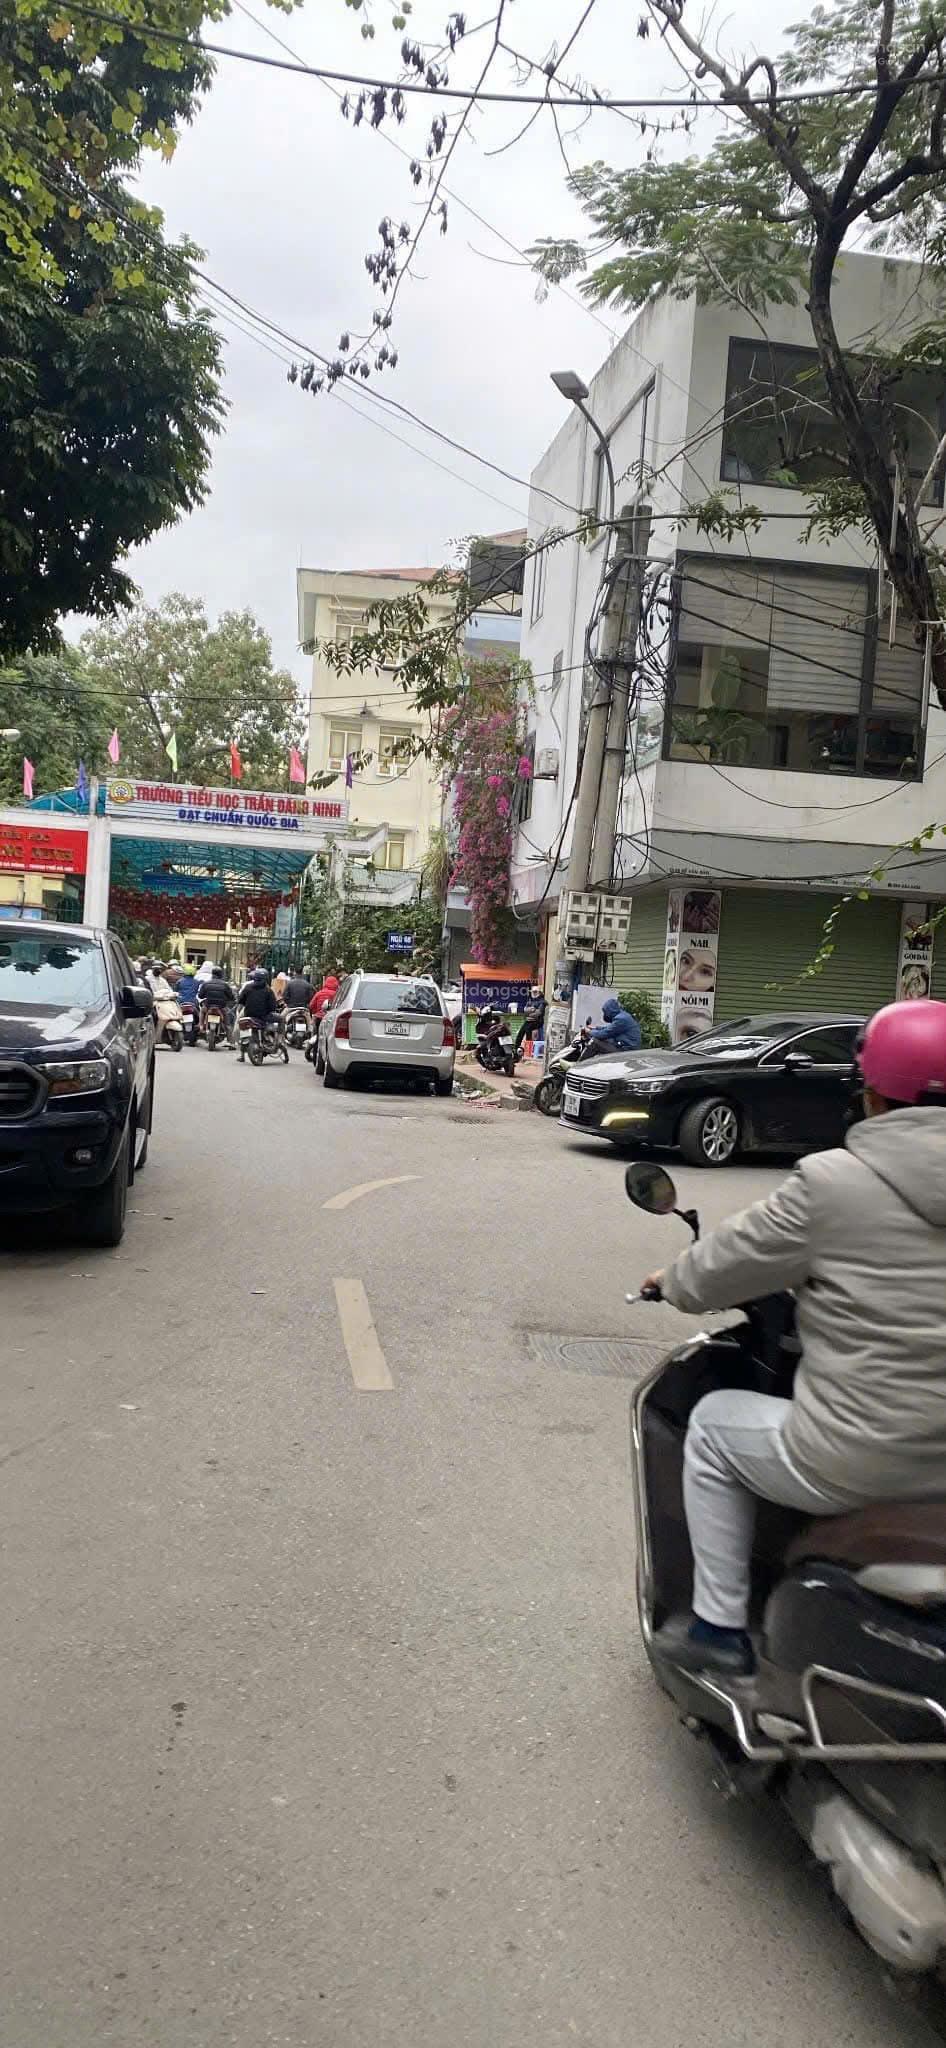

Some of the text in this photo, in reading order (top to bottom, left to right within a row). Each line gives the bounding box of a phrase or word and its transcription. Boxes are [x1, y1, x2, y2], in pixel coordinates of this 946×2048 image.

[136, 785, 183, 804] TRƯỜNG
[187, 788, 213, 807] TIỂU
[216, 793, 240, 811] HỌC
[243, 793, 275, 812] TRẦN
[313, 802, 341, 817] NINH
[178, 809, 299, 829] ĐẠT CHUẨN QUỐC GIA
[690, 938, 711, 948] NAIL
